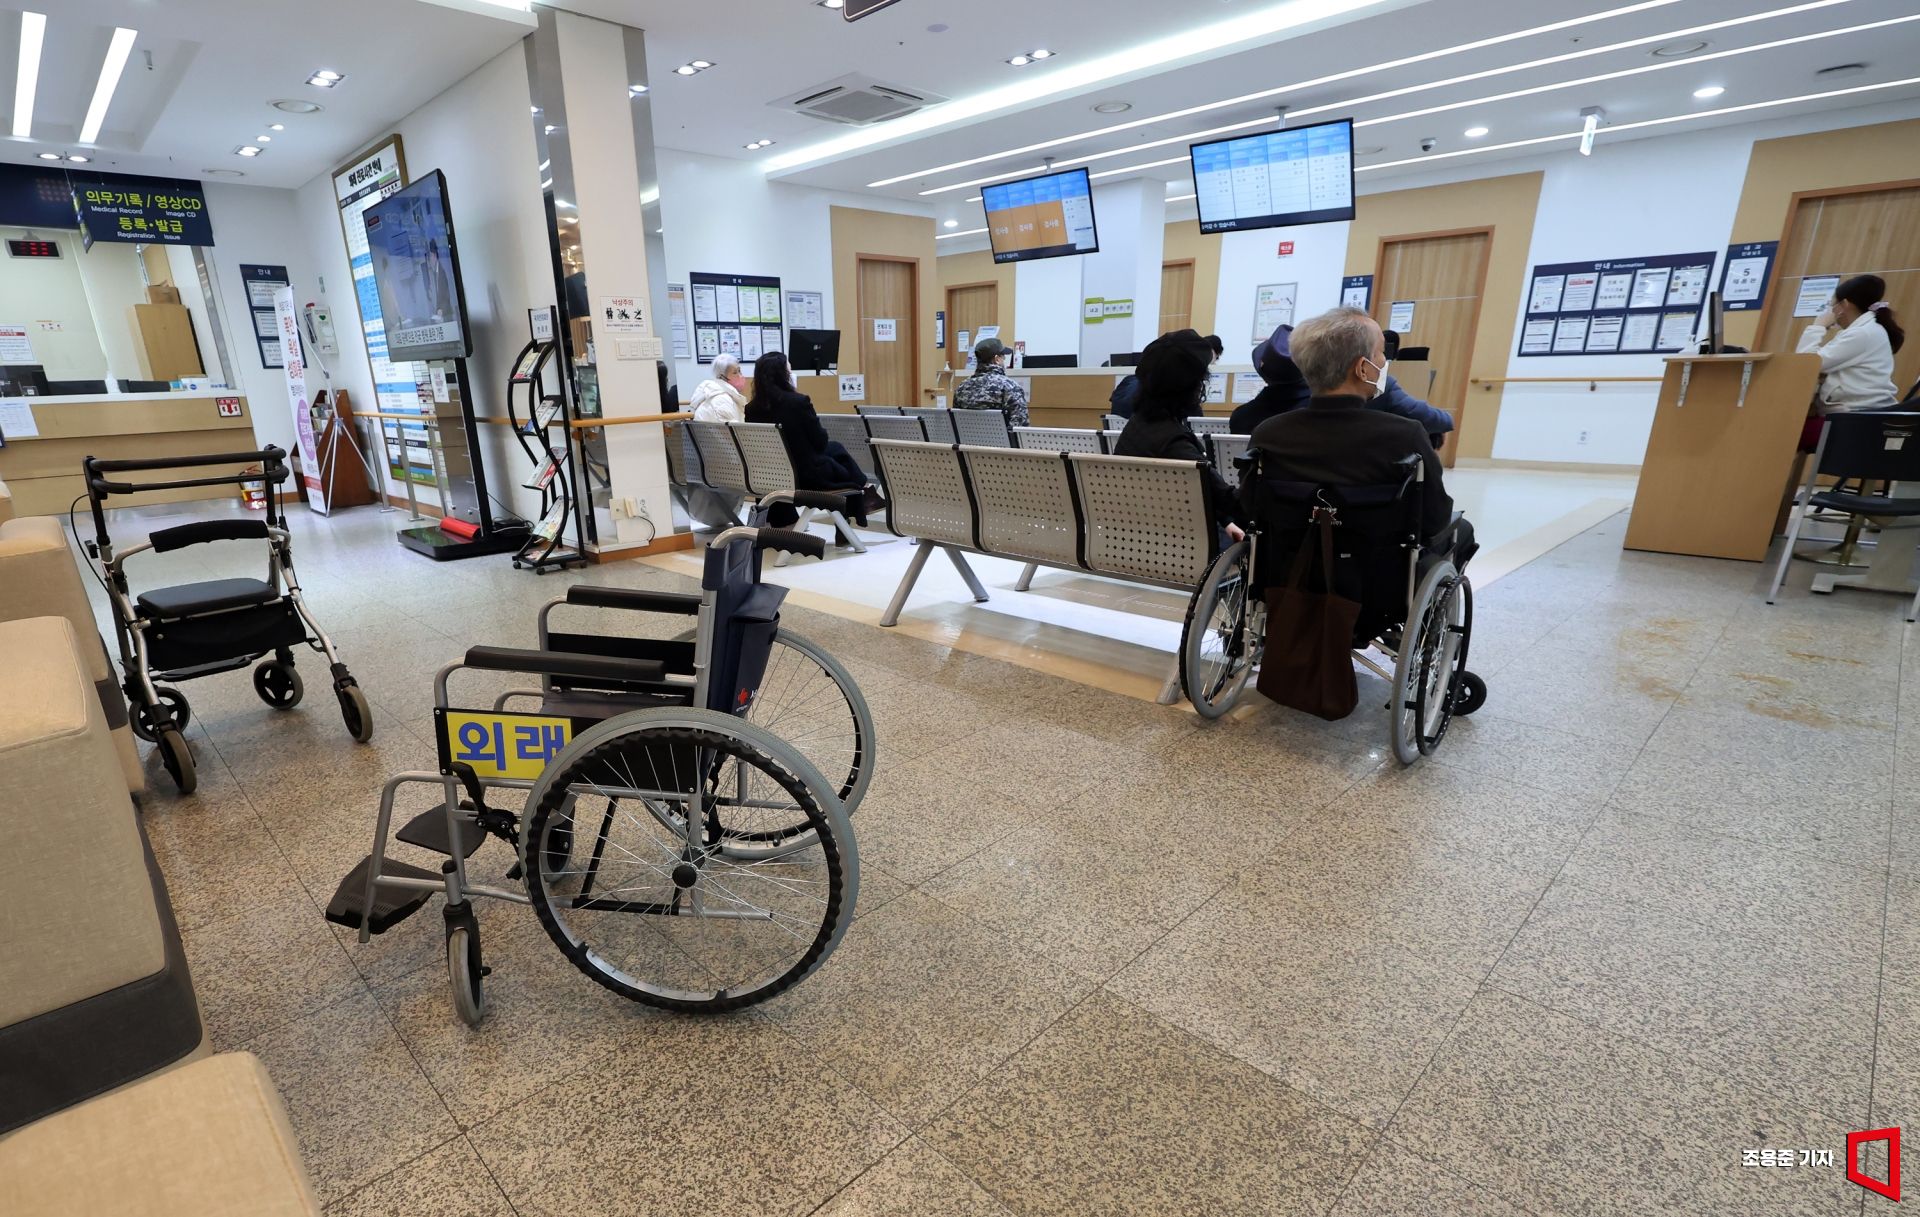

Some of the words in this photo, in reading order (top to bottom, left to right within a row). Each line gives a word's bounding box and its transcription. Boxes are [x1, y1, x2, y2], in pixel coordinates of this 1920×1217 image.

[85, 190, 143, 207] 의무기록
[154, 194, 201, 210] 영상CD
[91, 205, 118, 213] Medical
[119, 207, 143, 215] Record
[166, 210, 185, 218] Image
[117, 230, 156, 239] Registration
[1743, 268, 1751, 277] 5
[457, 722, 565, 771] 외래
